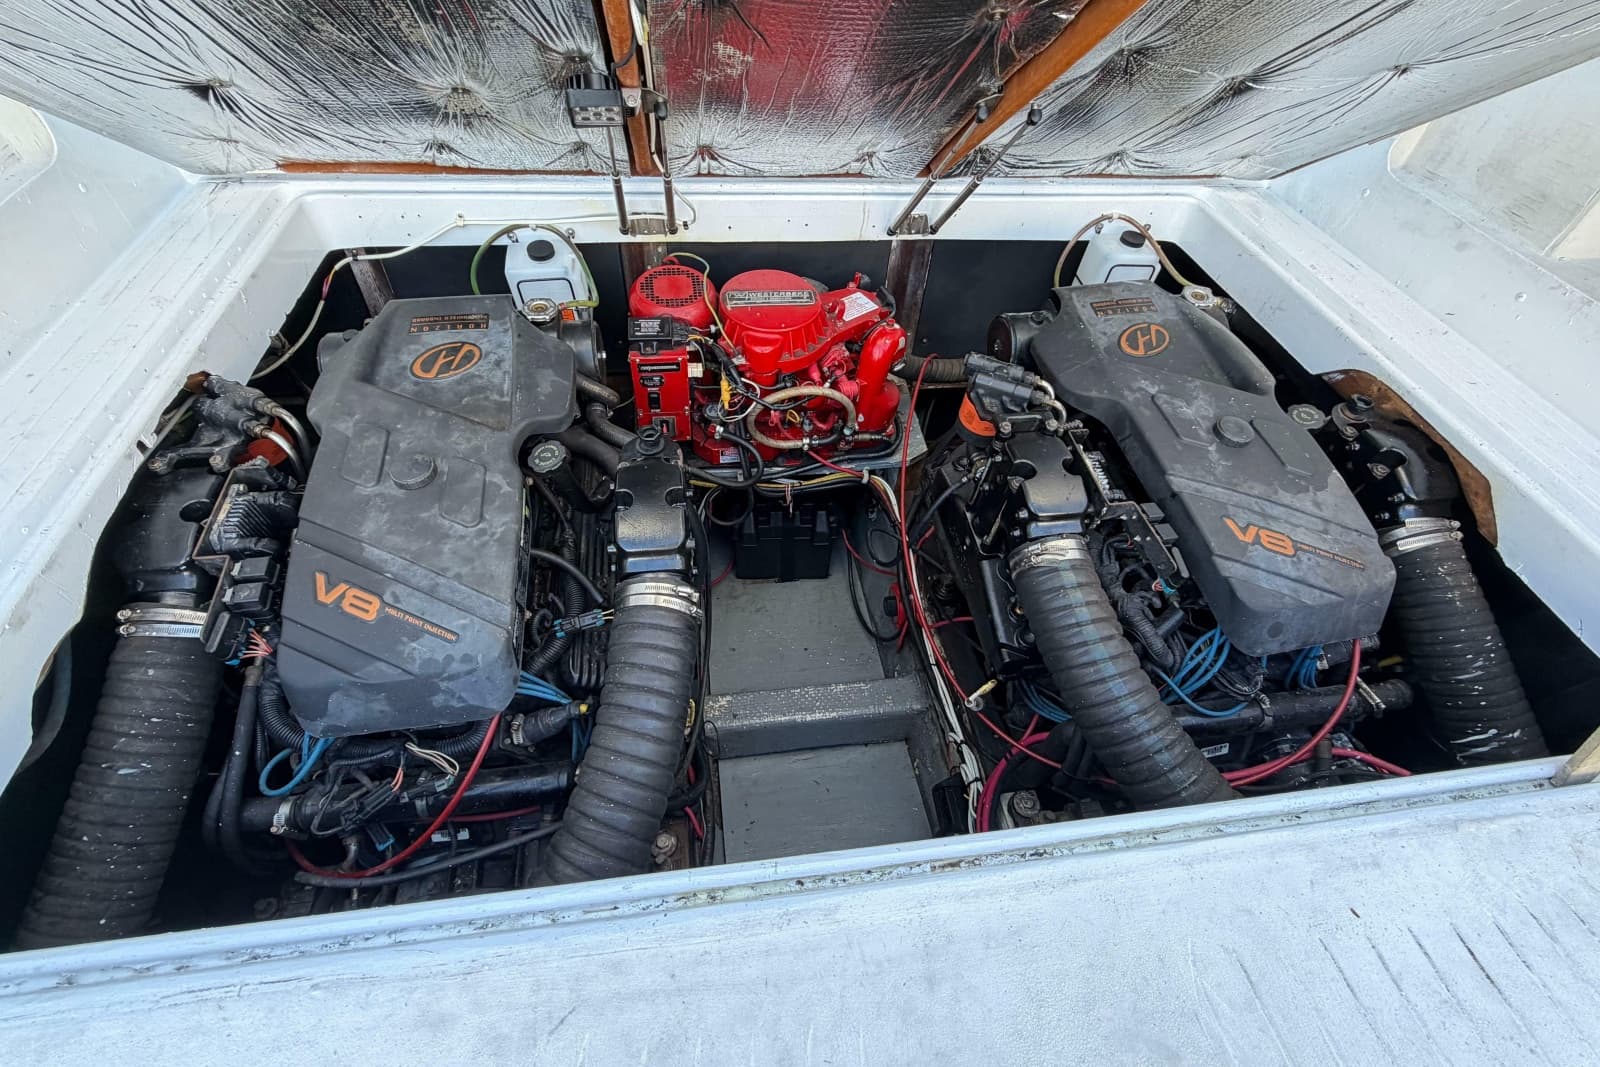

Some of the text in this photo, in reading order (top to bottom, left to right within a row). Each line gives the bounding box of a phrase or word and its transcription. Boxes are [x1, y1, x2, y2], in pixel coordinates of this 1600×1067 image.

[410, 323, 487, 332] HORIZON
[1223, 517, 1295, 556] V8
[315, 571, 380, 621] V8
[385, 607, 457, 641] MULTI POINT INJECTION
